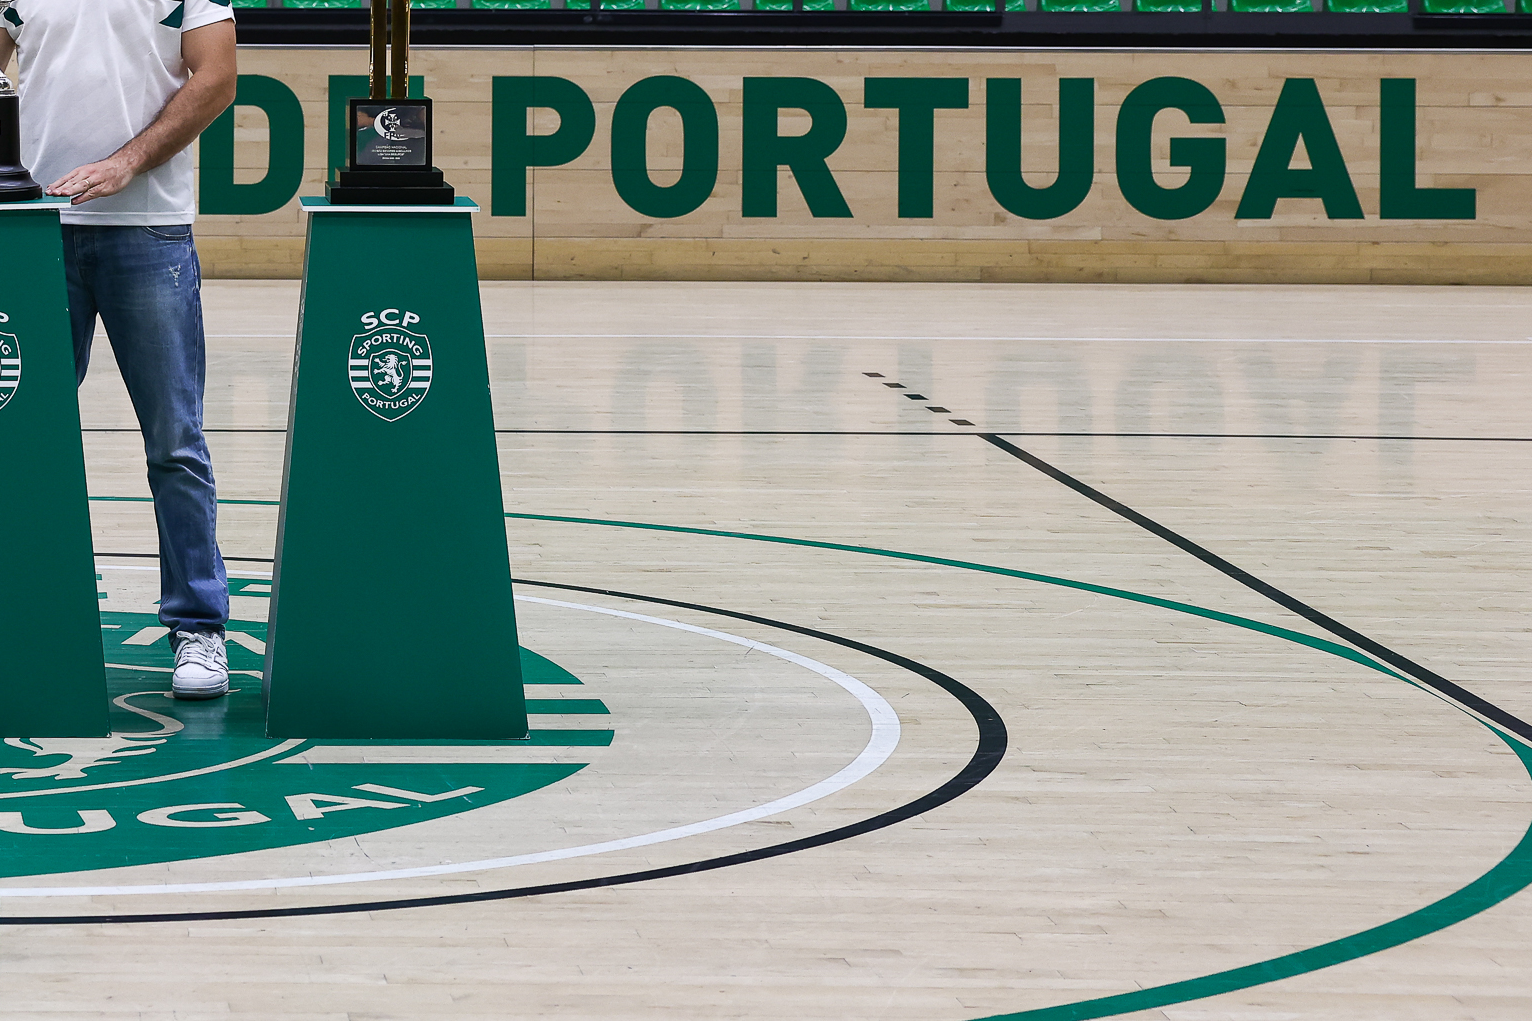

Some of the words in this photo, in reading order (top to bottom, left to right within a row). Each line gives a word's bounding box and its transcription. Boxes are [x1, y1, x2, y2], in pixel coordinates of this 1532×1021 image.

[491, 75, 1476, 220] PORTUGAL
[360, 308, 420, 329] SCP
[357, 333, 423, 357] SPORTING
[361, 392, 421, 409] PORTUGAL
